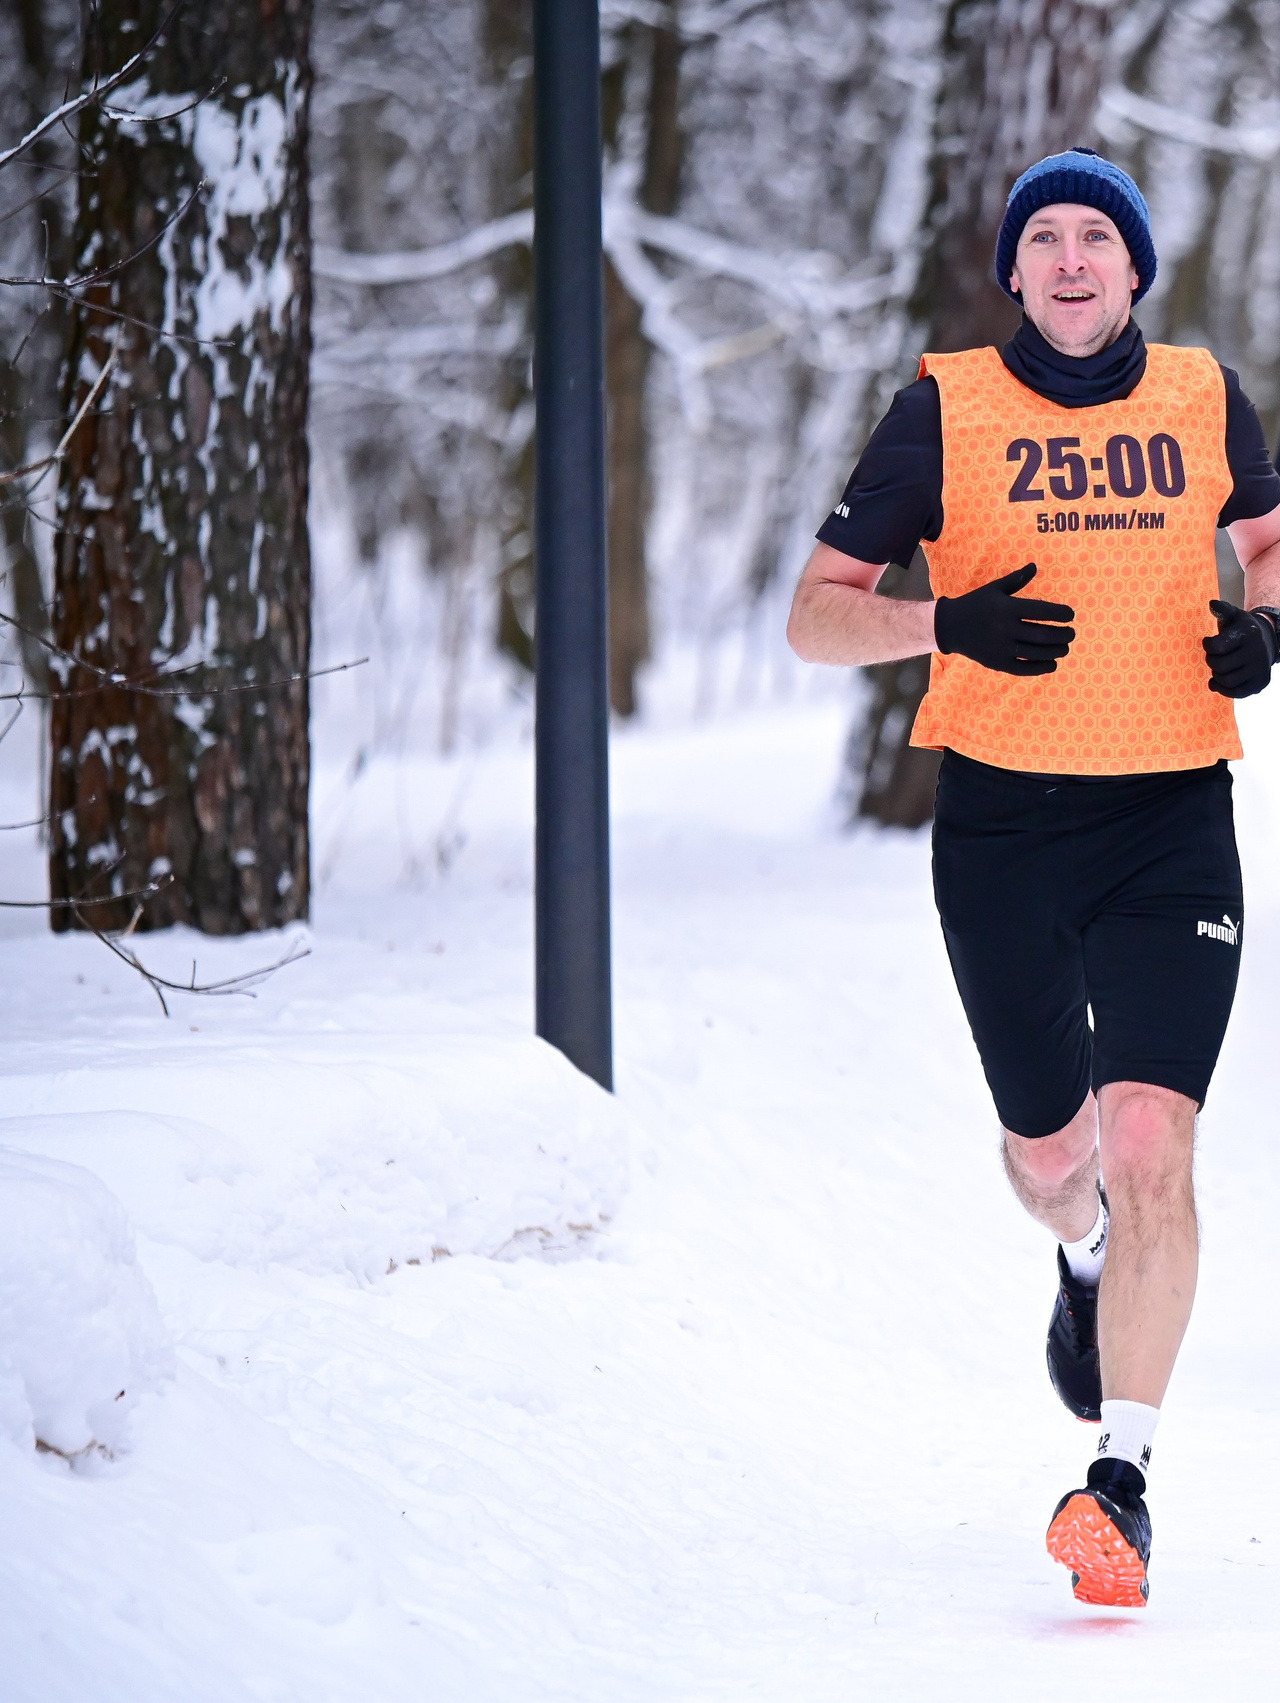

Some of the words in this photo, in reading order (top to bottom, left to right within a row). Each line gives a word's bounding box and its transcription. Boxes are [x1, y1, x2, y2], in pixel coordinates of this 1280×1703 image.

[1005, 432, 1187, 503] 25:00
[1036, 511, 1080, 534] 5:00
[1196, 920, 1235, 946] PUMA
